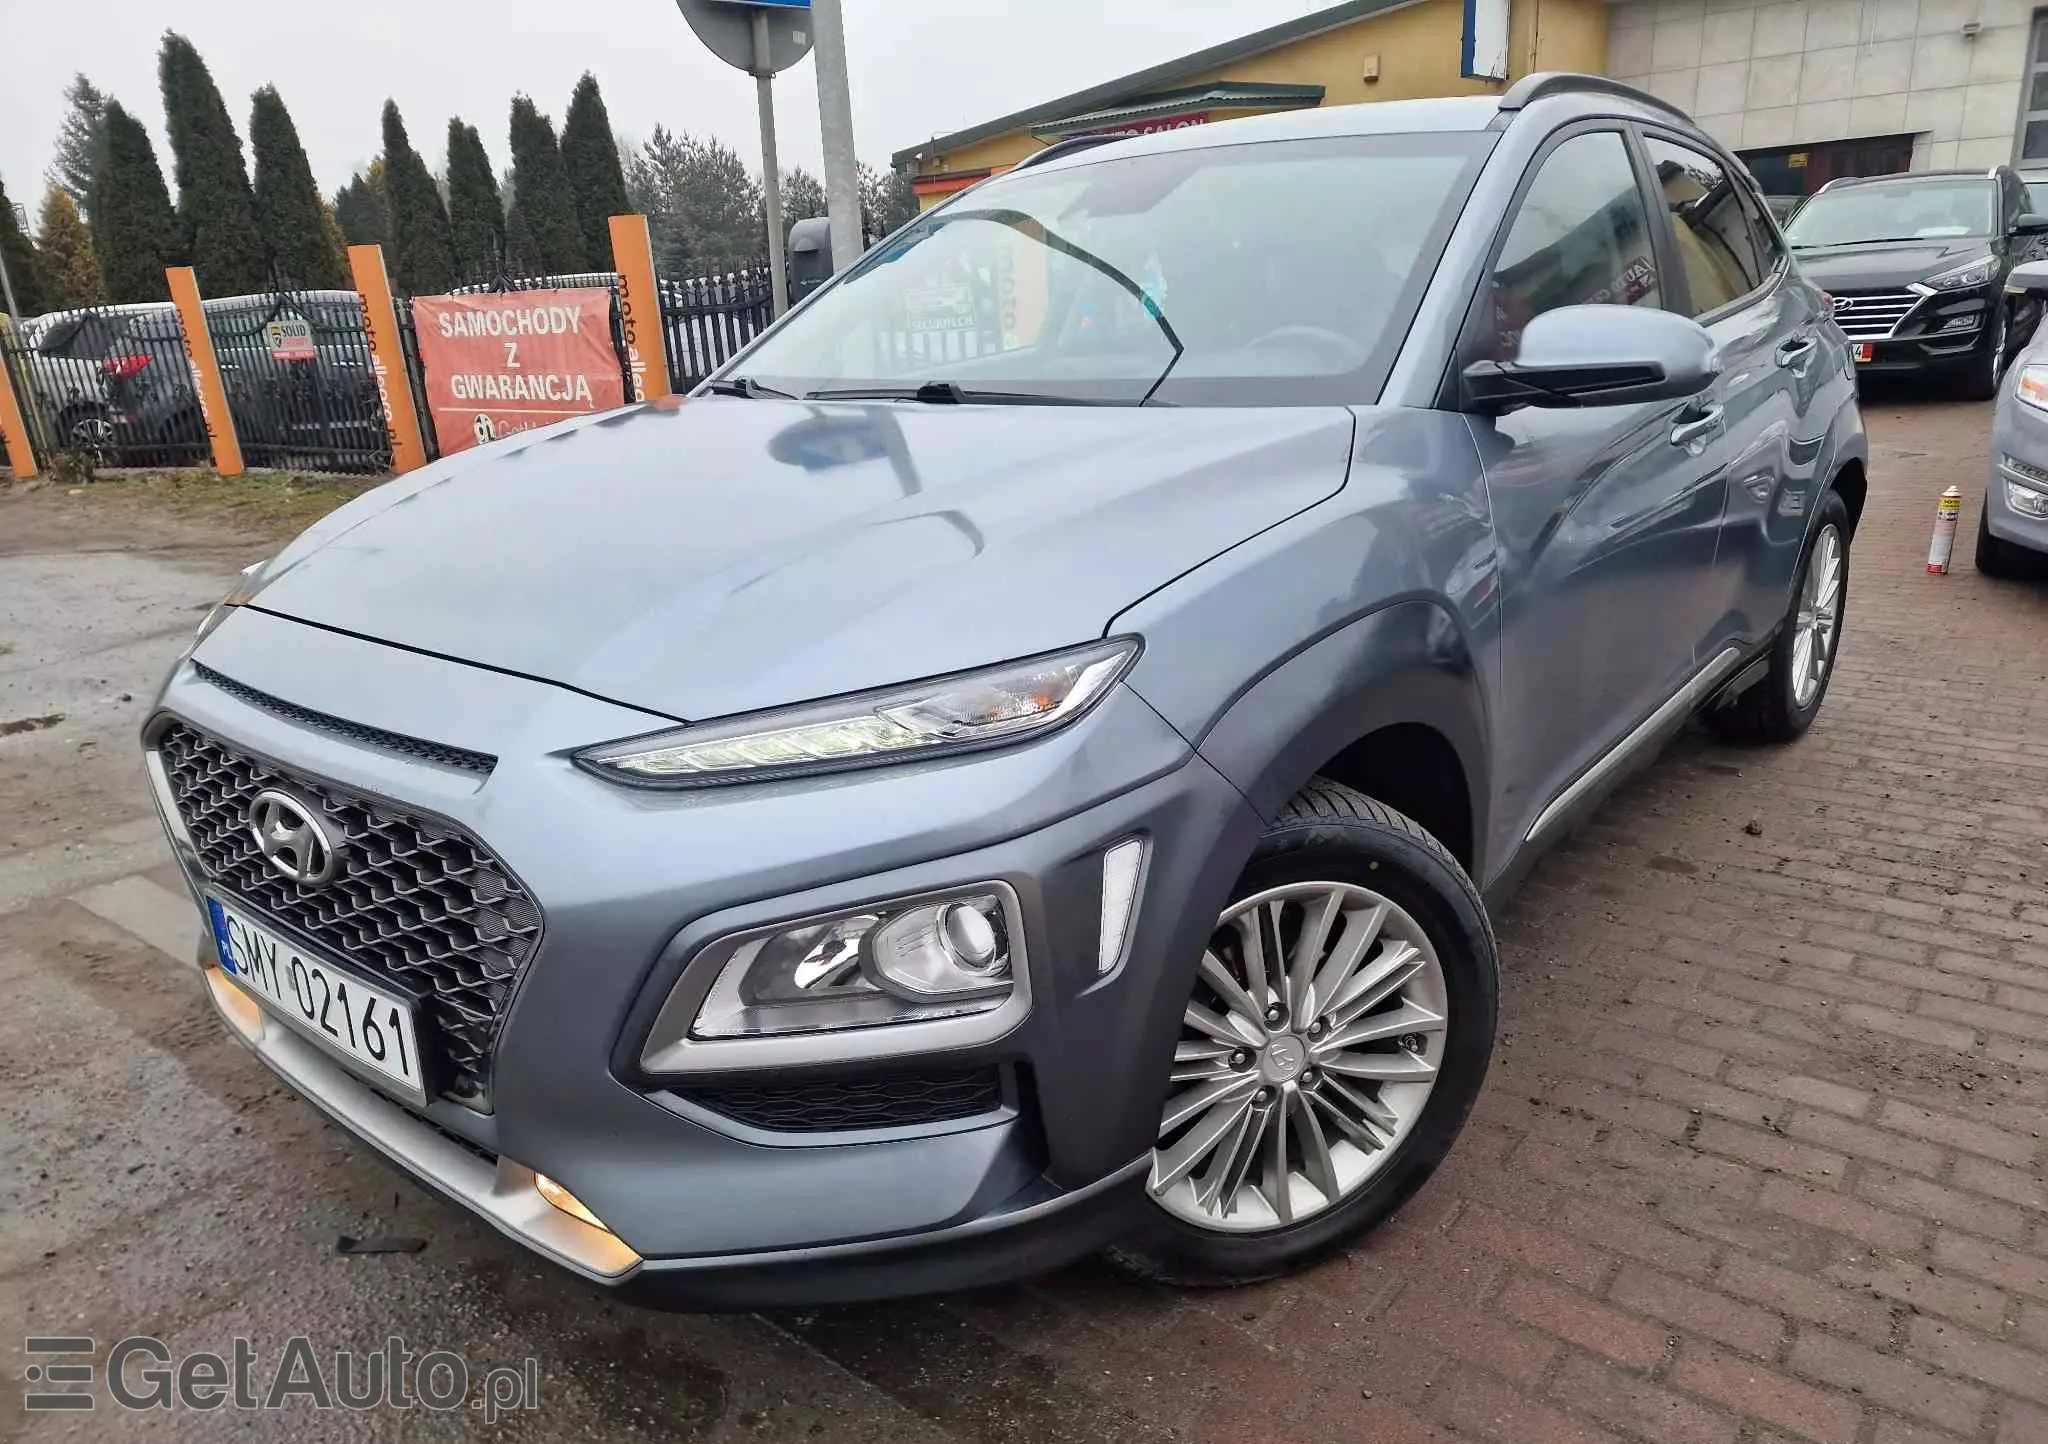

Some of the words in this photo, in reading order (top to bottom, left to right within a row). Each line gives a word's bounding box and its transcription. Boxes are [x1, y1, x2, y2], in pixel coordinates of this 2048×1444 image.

[438, 306, 581, 338] SAMOCHODY
[503, 342, 521, 368] Z
[450, 374, 595, 409] GWARANCJĄ
[226, 914, 282, 1001] SMY
[291, 956, 409, 1076] 02161
